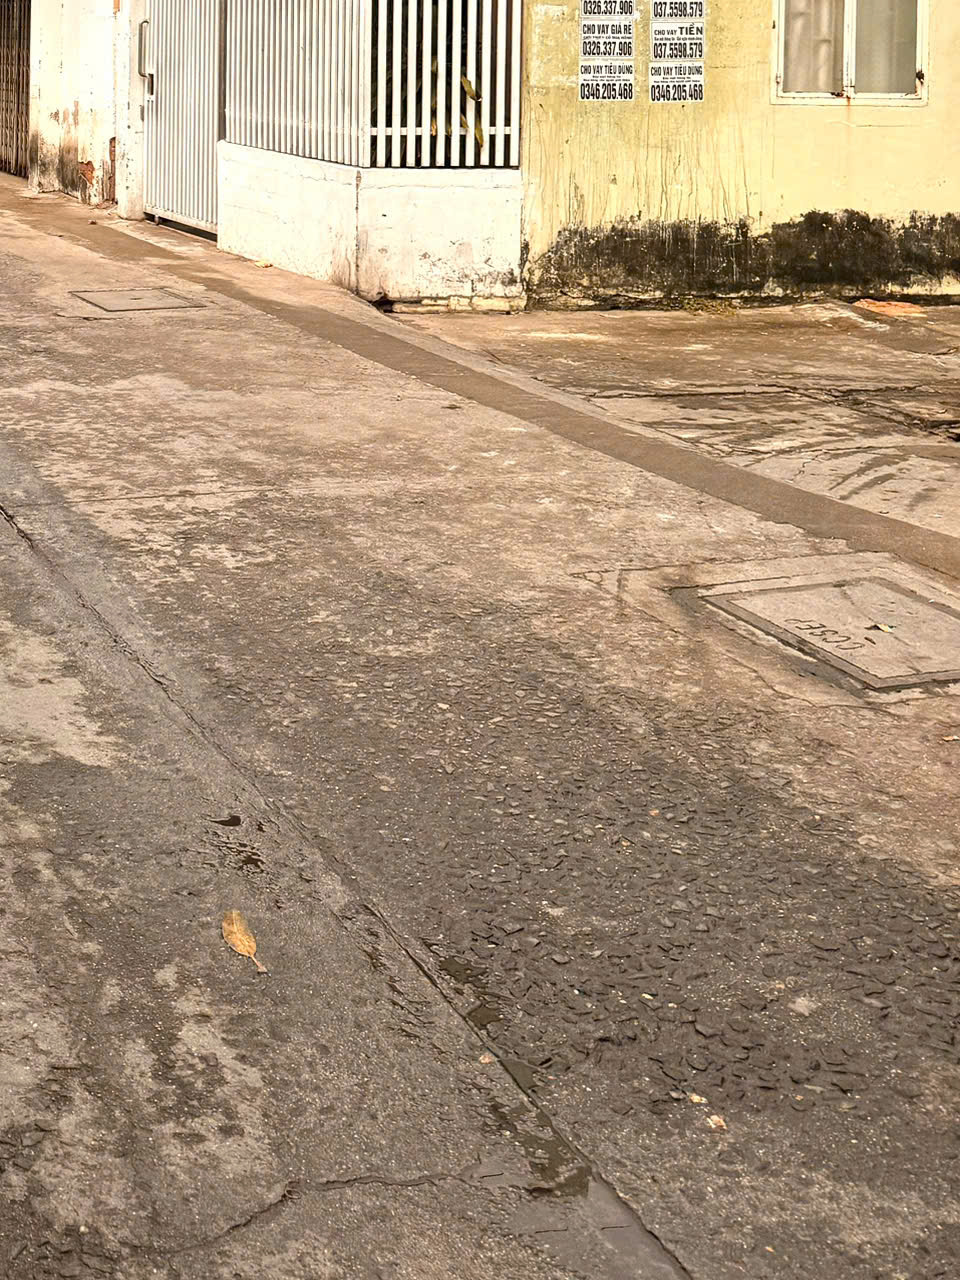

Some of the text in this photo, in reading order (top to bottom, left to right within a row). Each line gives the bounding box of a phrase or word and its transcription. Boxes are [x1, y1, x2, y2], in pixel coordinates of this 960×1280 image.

[583, 0, 633, 15] 0326.337.906
[653, 1, 703, 18] 037.5598.579
[582, 24, 596, 34] CHO
[597, 24, 609, 34] VAY
[678, 22, 703, 35] TIỀN
[582, 41, 632, 56] 0326.337.906
[653, 42, 703, 58] 037.5598.579
[580, 64, 591, 75] CHO
[593, 64, 603, 75] VAY
[651, 66, 661, 76] CHO
[662, 66, 673, 76] VAY
[580, 83, 633, 100] 0346.205.468
[651, 84, 703, 101] 0346.205.468
